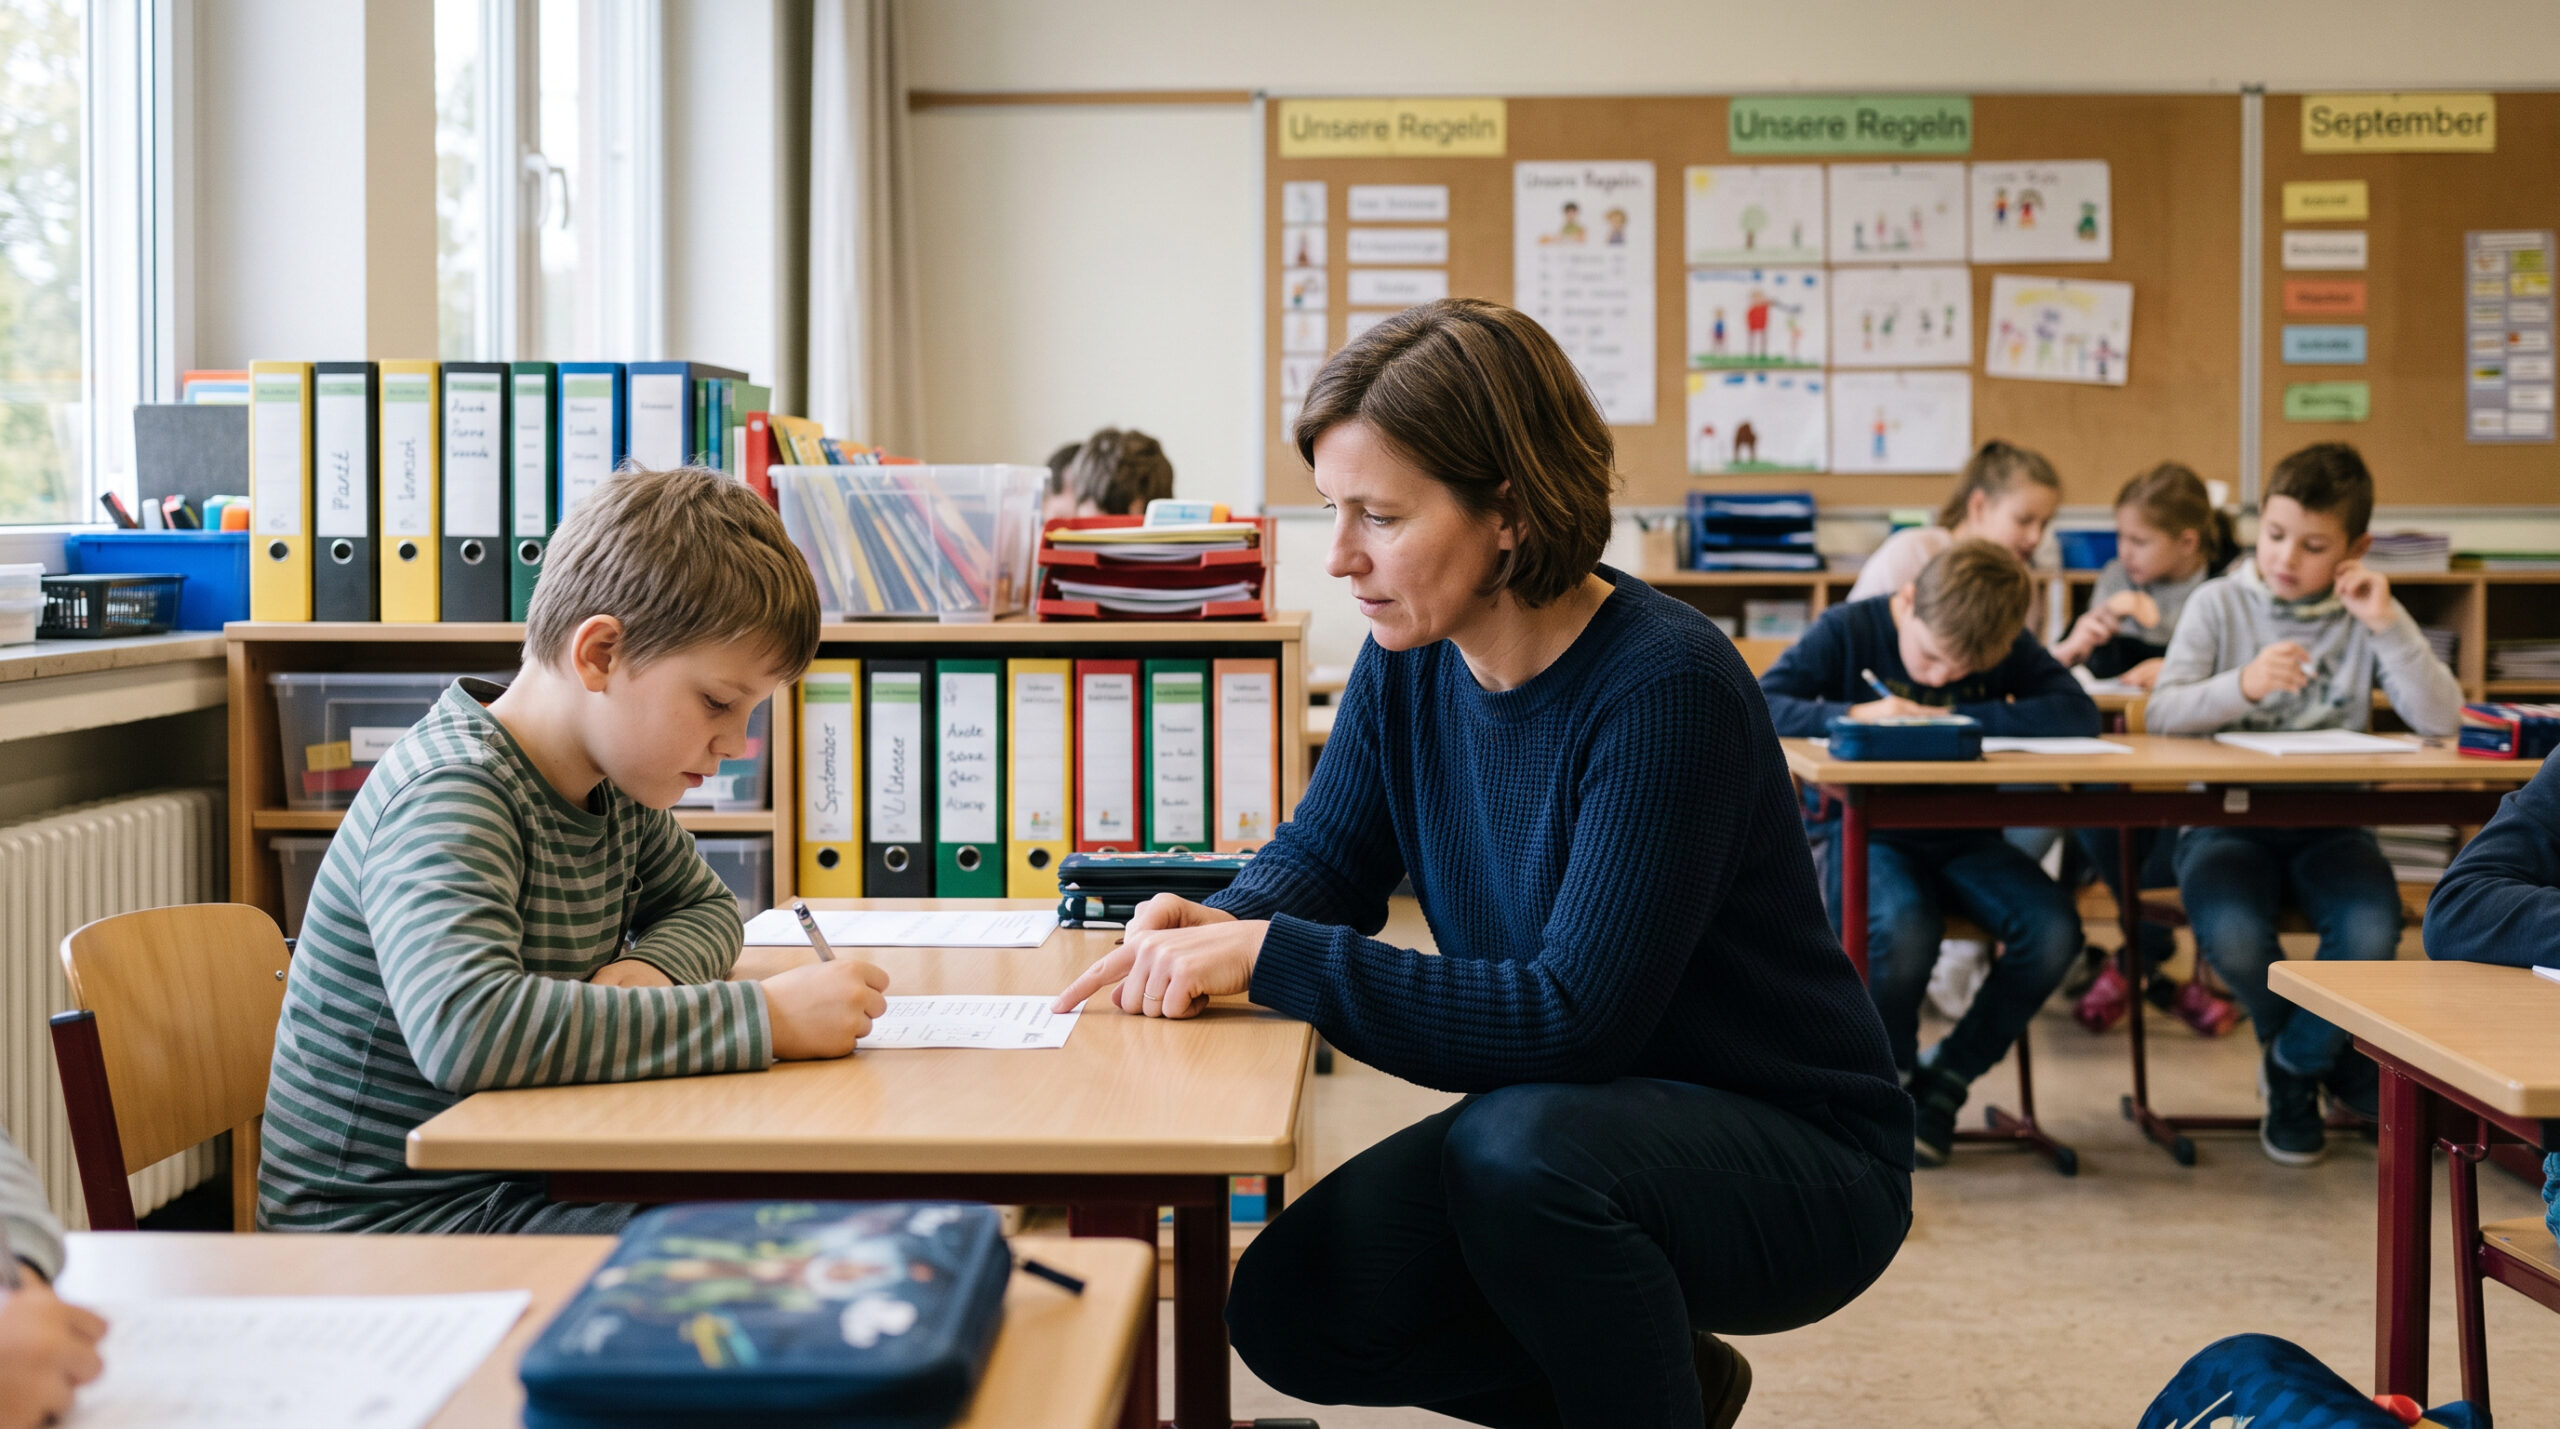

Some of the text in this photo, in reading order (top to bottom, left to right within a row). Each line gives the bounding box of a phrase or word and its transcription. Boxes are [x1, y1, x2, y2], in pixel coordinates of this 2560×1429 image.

[1288, 112, 1498, 148] Unsere Regeln
[1733, 107, 1967, 148] Unsere Regeln
[2310, 105, 2488, 142] September
